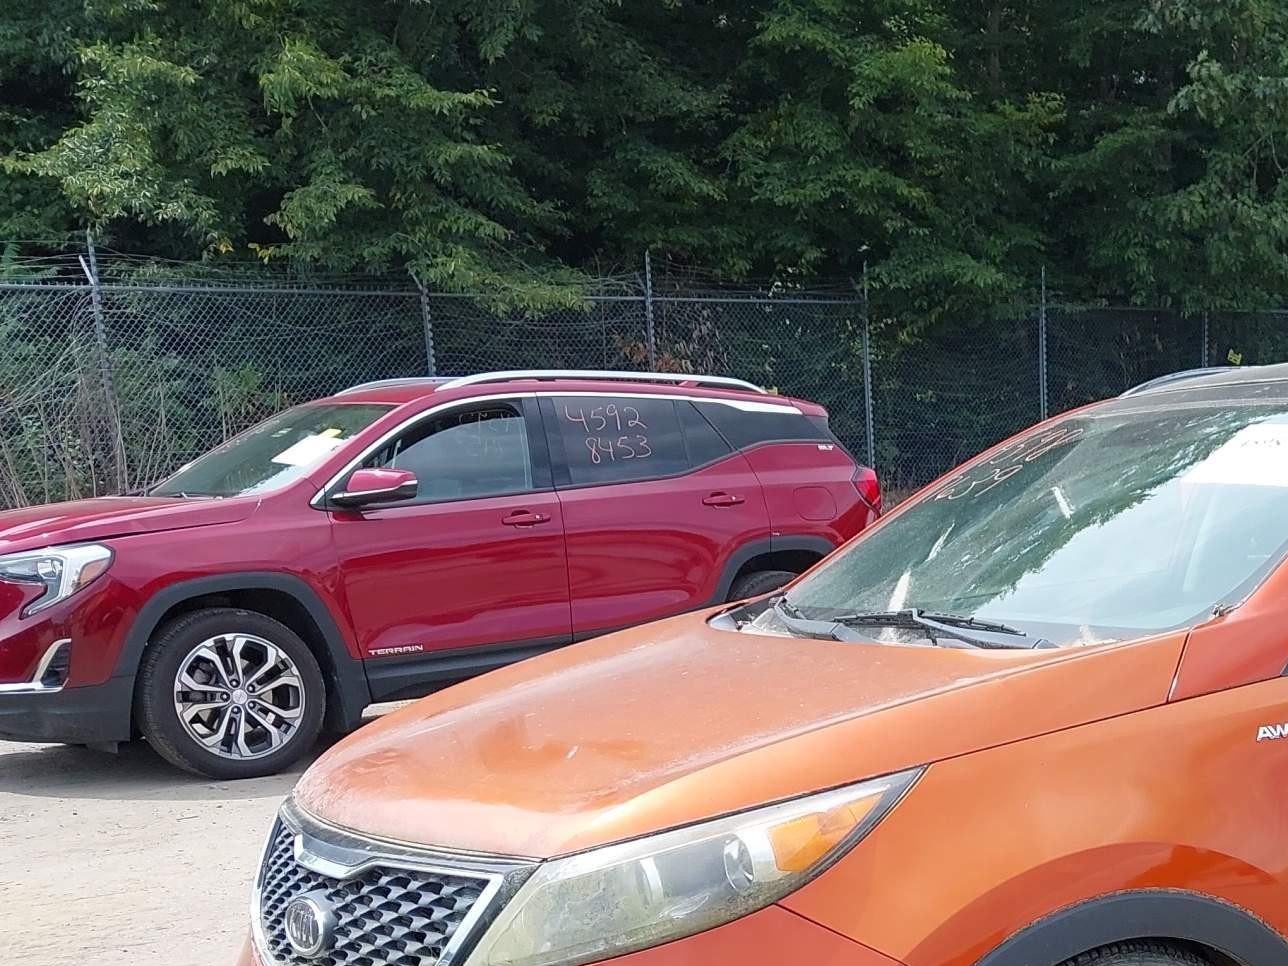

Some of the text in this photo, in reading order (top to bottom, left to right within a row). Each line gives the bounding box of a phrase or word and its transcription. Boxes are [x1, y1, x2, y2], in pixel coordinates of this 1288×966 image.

[565, 404, 647, 432] 4592
[585, 434, 651, 463] 8453
[368, 644, 423, 656] TERRAIN
